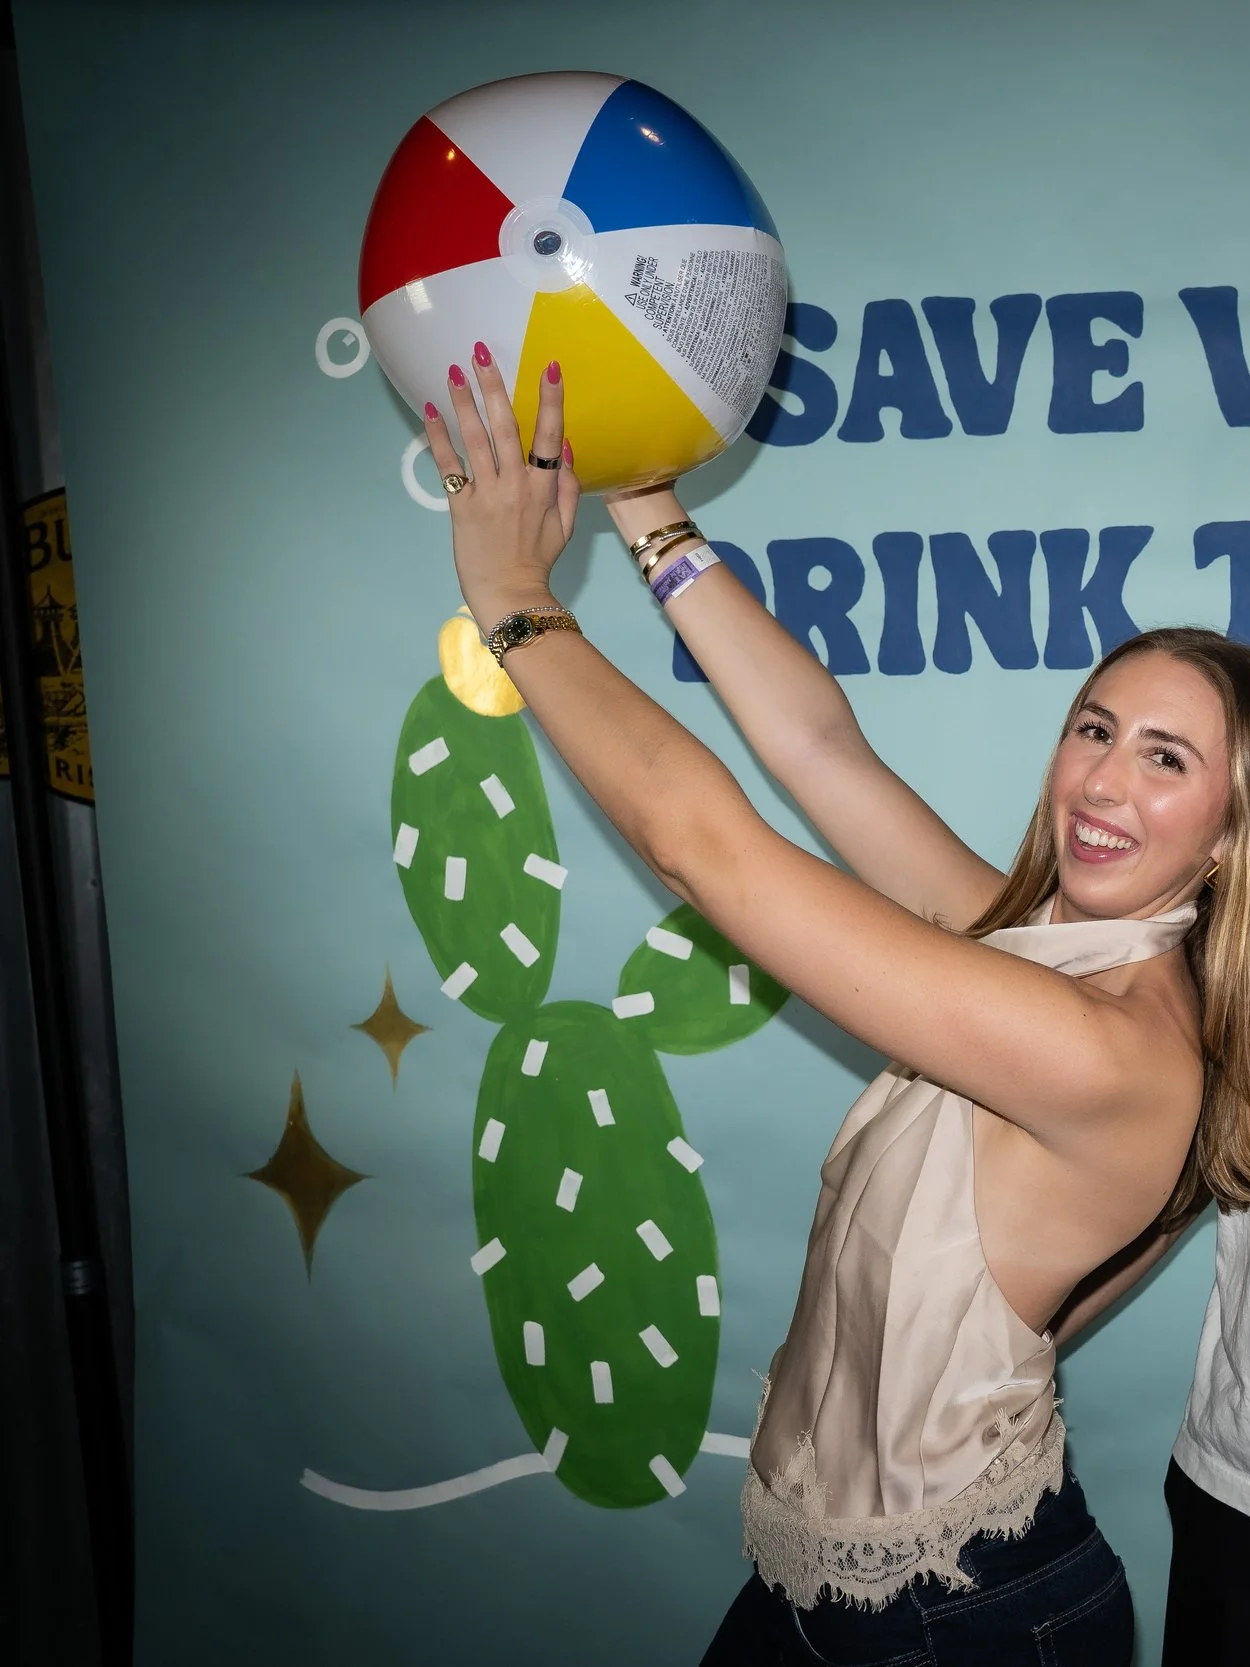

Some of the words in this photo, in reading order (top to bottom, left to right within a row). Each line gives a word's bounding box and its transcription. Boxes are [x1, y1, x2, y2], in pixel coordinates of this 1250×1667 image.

[630, 254, 646, 287] WARNING!
[639, 277, 652, 296] ONLY
[644, 256, 658, 279] UNDER
[636, 295, 647, 309] USE
[644, 276, 664, 320] COMPETENT
[653, 280, 674, 329] SUPERVISION.
[745, 291, 1144, 447] SAVE
[672, 525, 1154, 684] RINK
